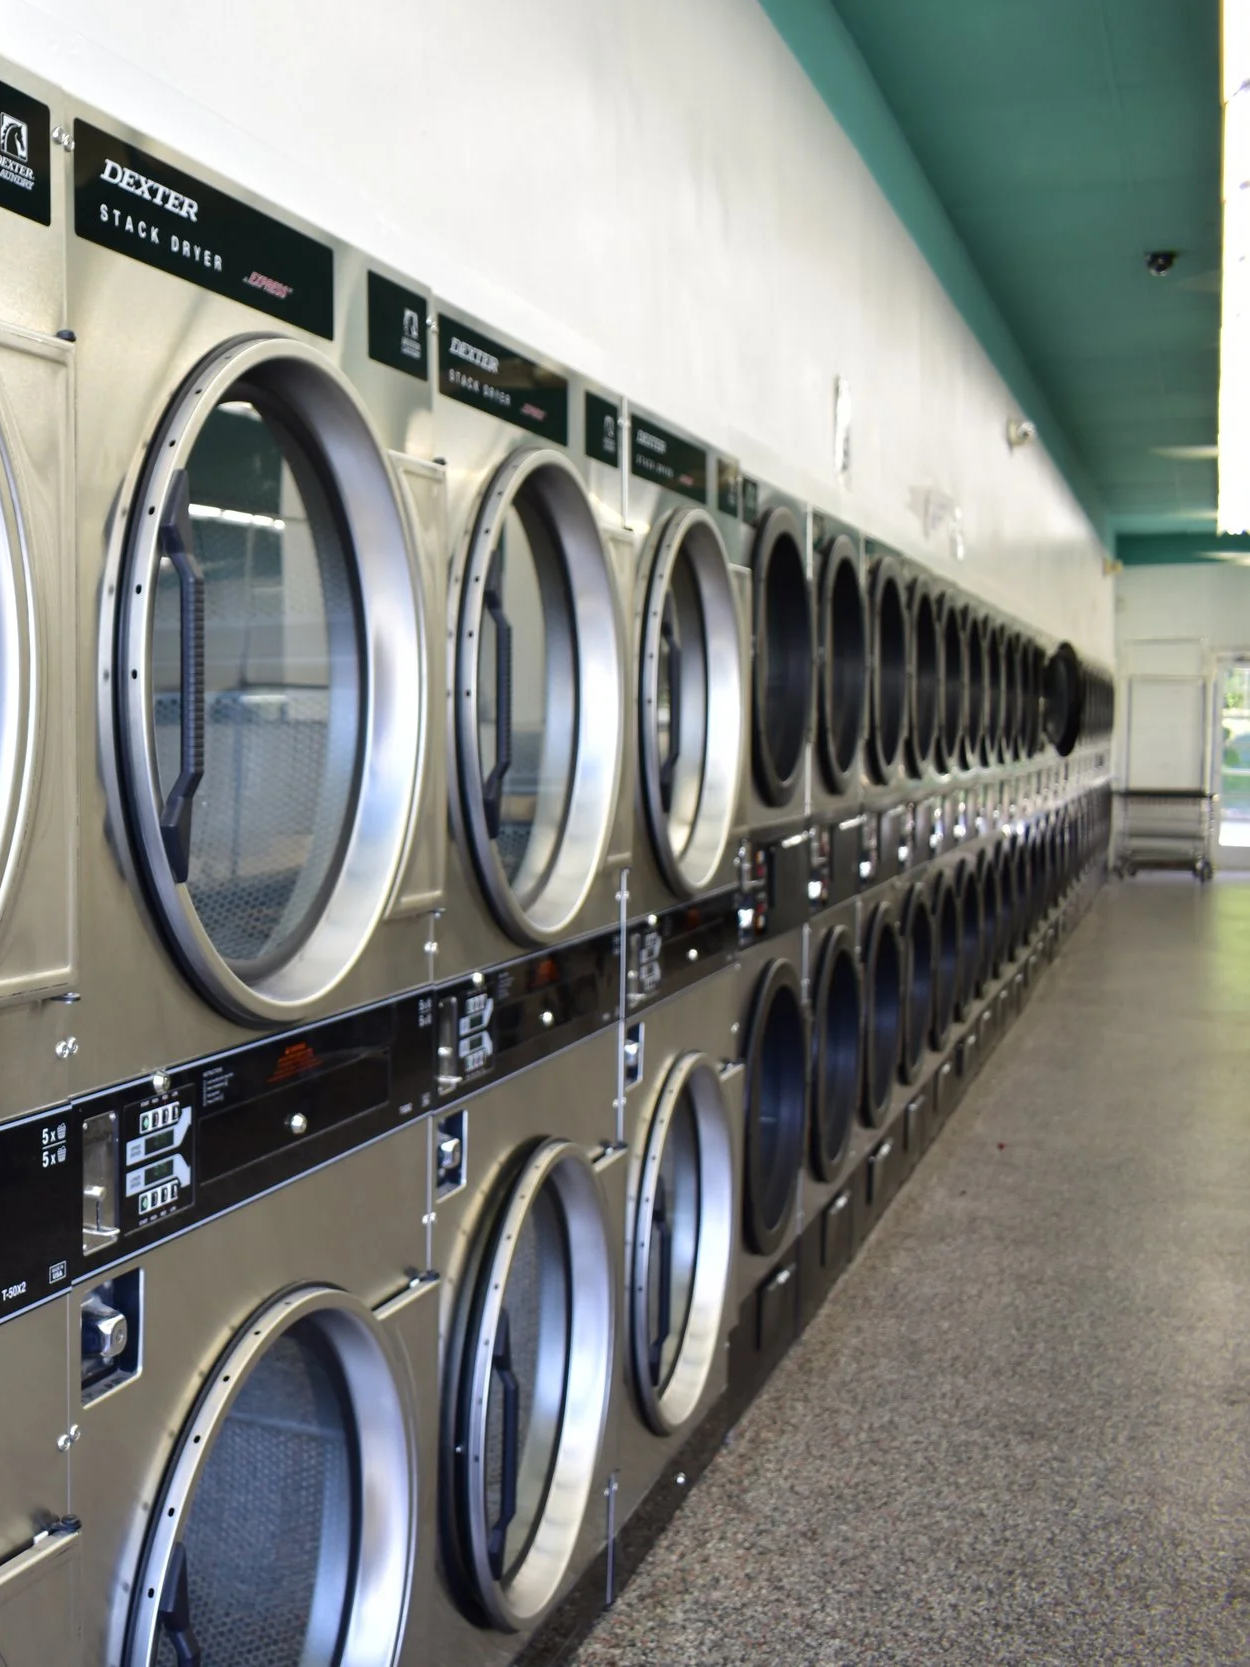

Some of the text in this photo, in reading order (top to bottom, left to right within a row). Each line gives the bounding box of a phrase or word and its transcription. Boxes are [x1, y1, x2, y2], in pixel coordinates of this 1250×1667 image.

[100, 158, 198, 222] DEXTER
[100, 204, 222, 272] STACK DRYER
[449, 336, 499, 374] DEXTER
[42, 1128, 49, 1145] 5
[42, 1151, 49, 1168] 5
